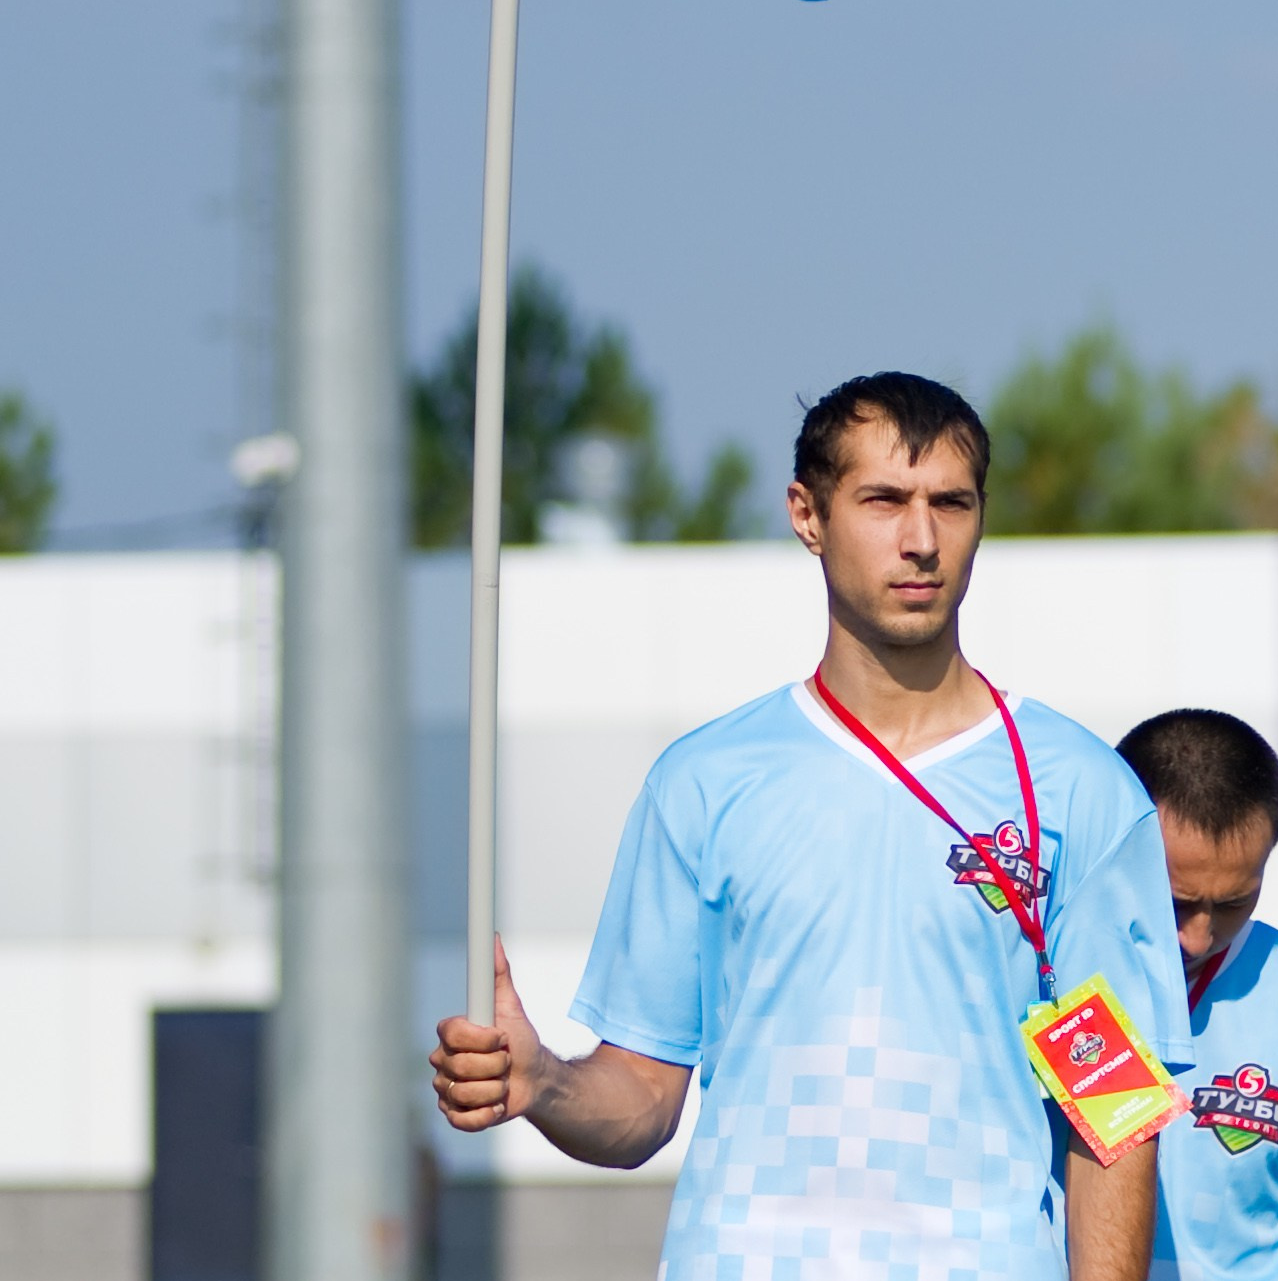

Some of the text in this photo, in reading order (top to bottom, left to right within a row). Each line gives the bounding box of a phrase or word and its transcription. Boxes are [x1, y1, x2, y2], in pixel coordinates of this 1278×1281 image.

[1048, 1007, 1095, 1043] SPORT ID
[1072, 1049, 1133, 1094] СПОРТСМЕН
